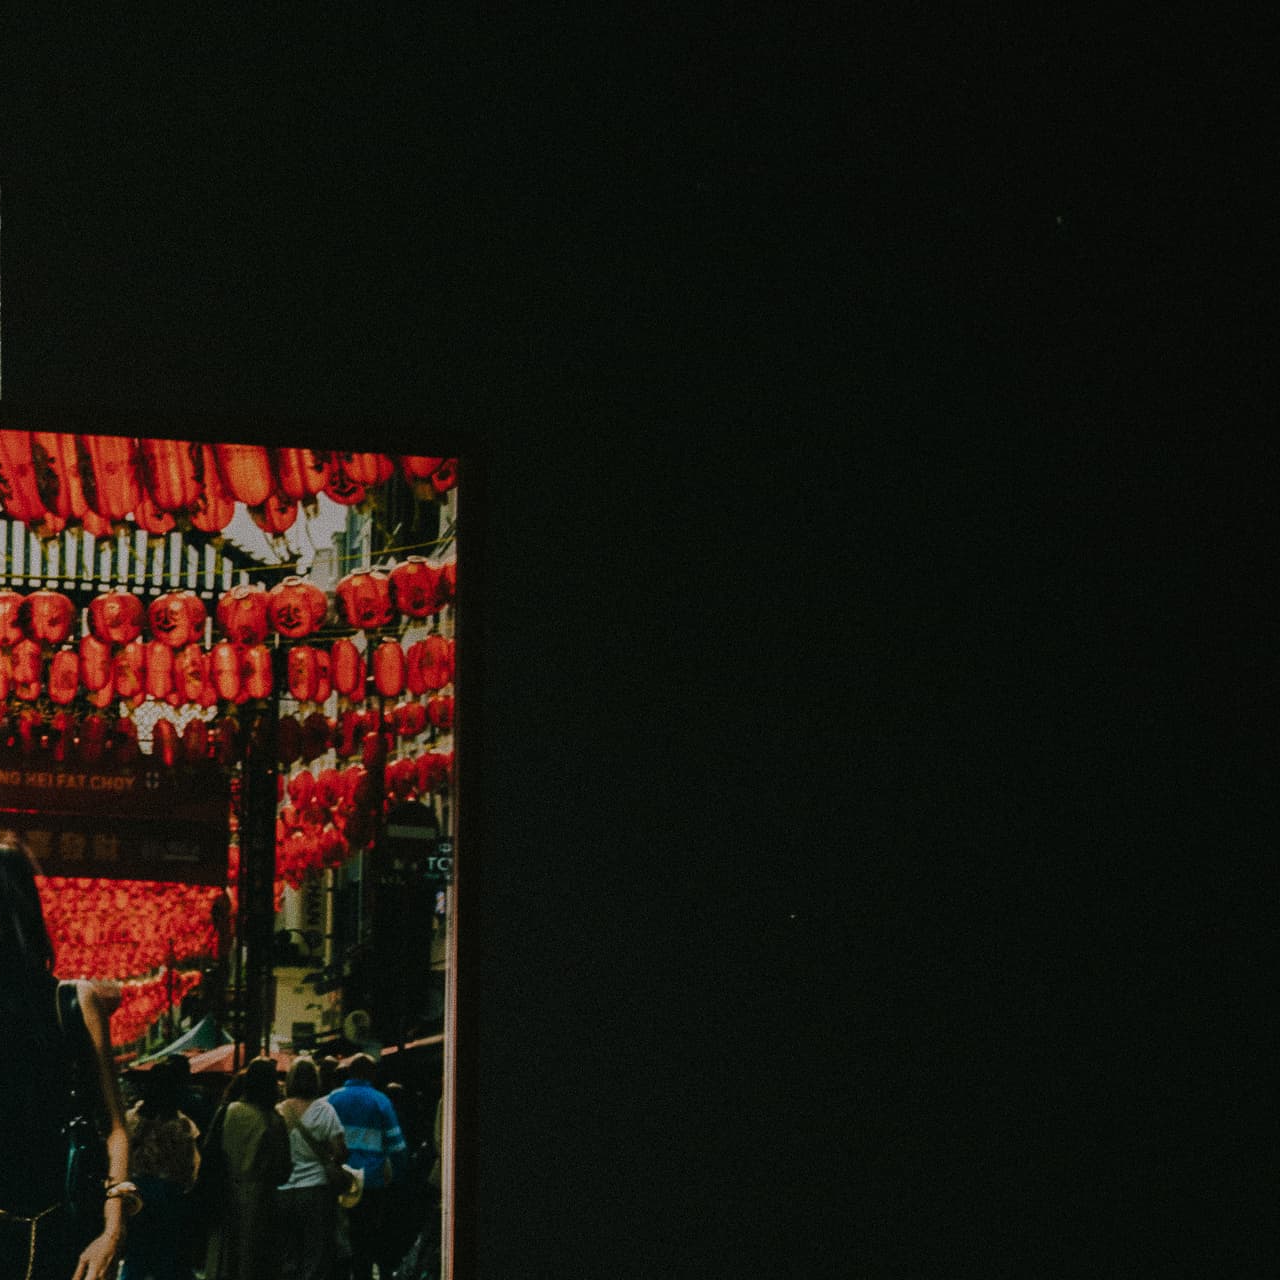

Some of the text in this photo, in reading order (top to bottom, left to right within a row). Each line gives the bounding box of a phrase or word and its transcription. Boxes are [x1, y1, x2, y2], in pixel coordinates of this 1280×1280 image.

[25, 770, 53, 787] HEI
[56, 772, 86, 789] FAT
[90, 775, 136, 791] CHOY
